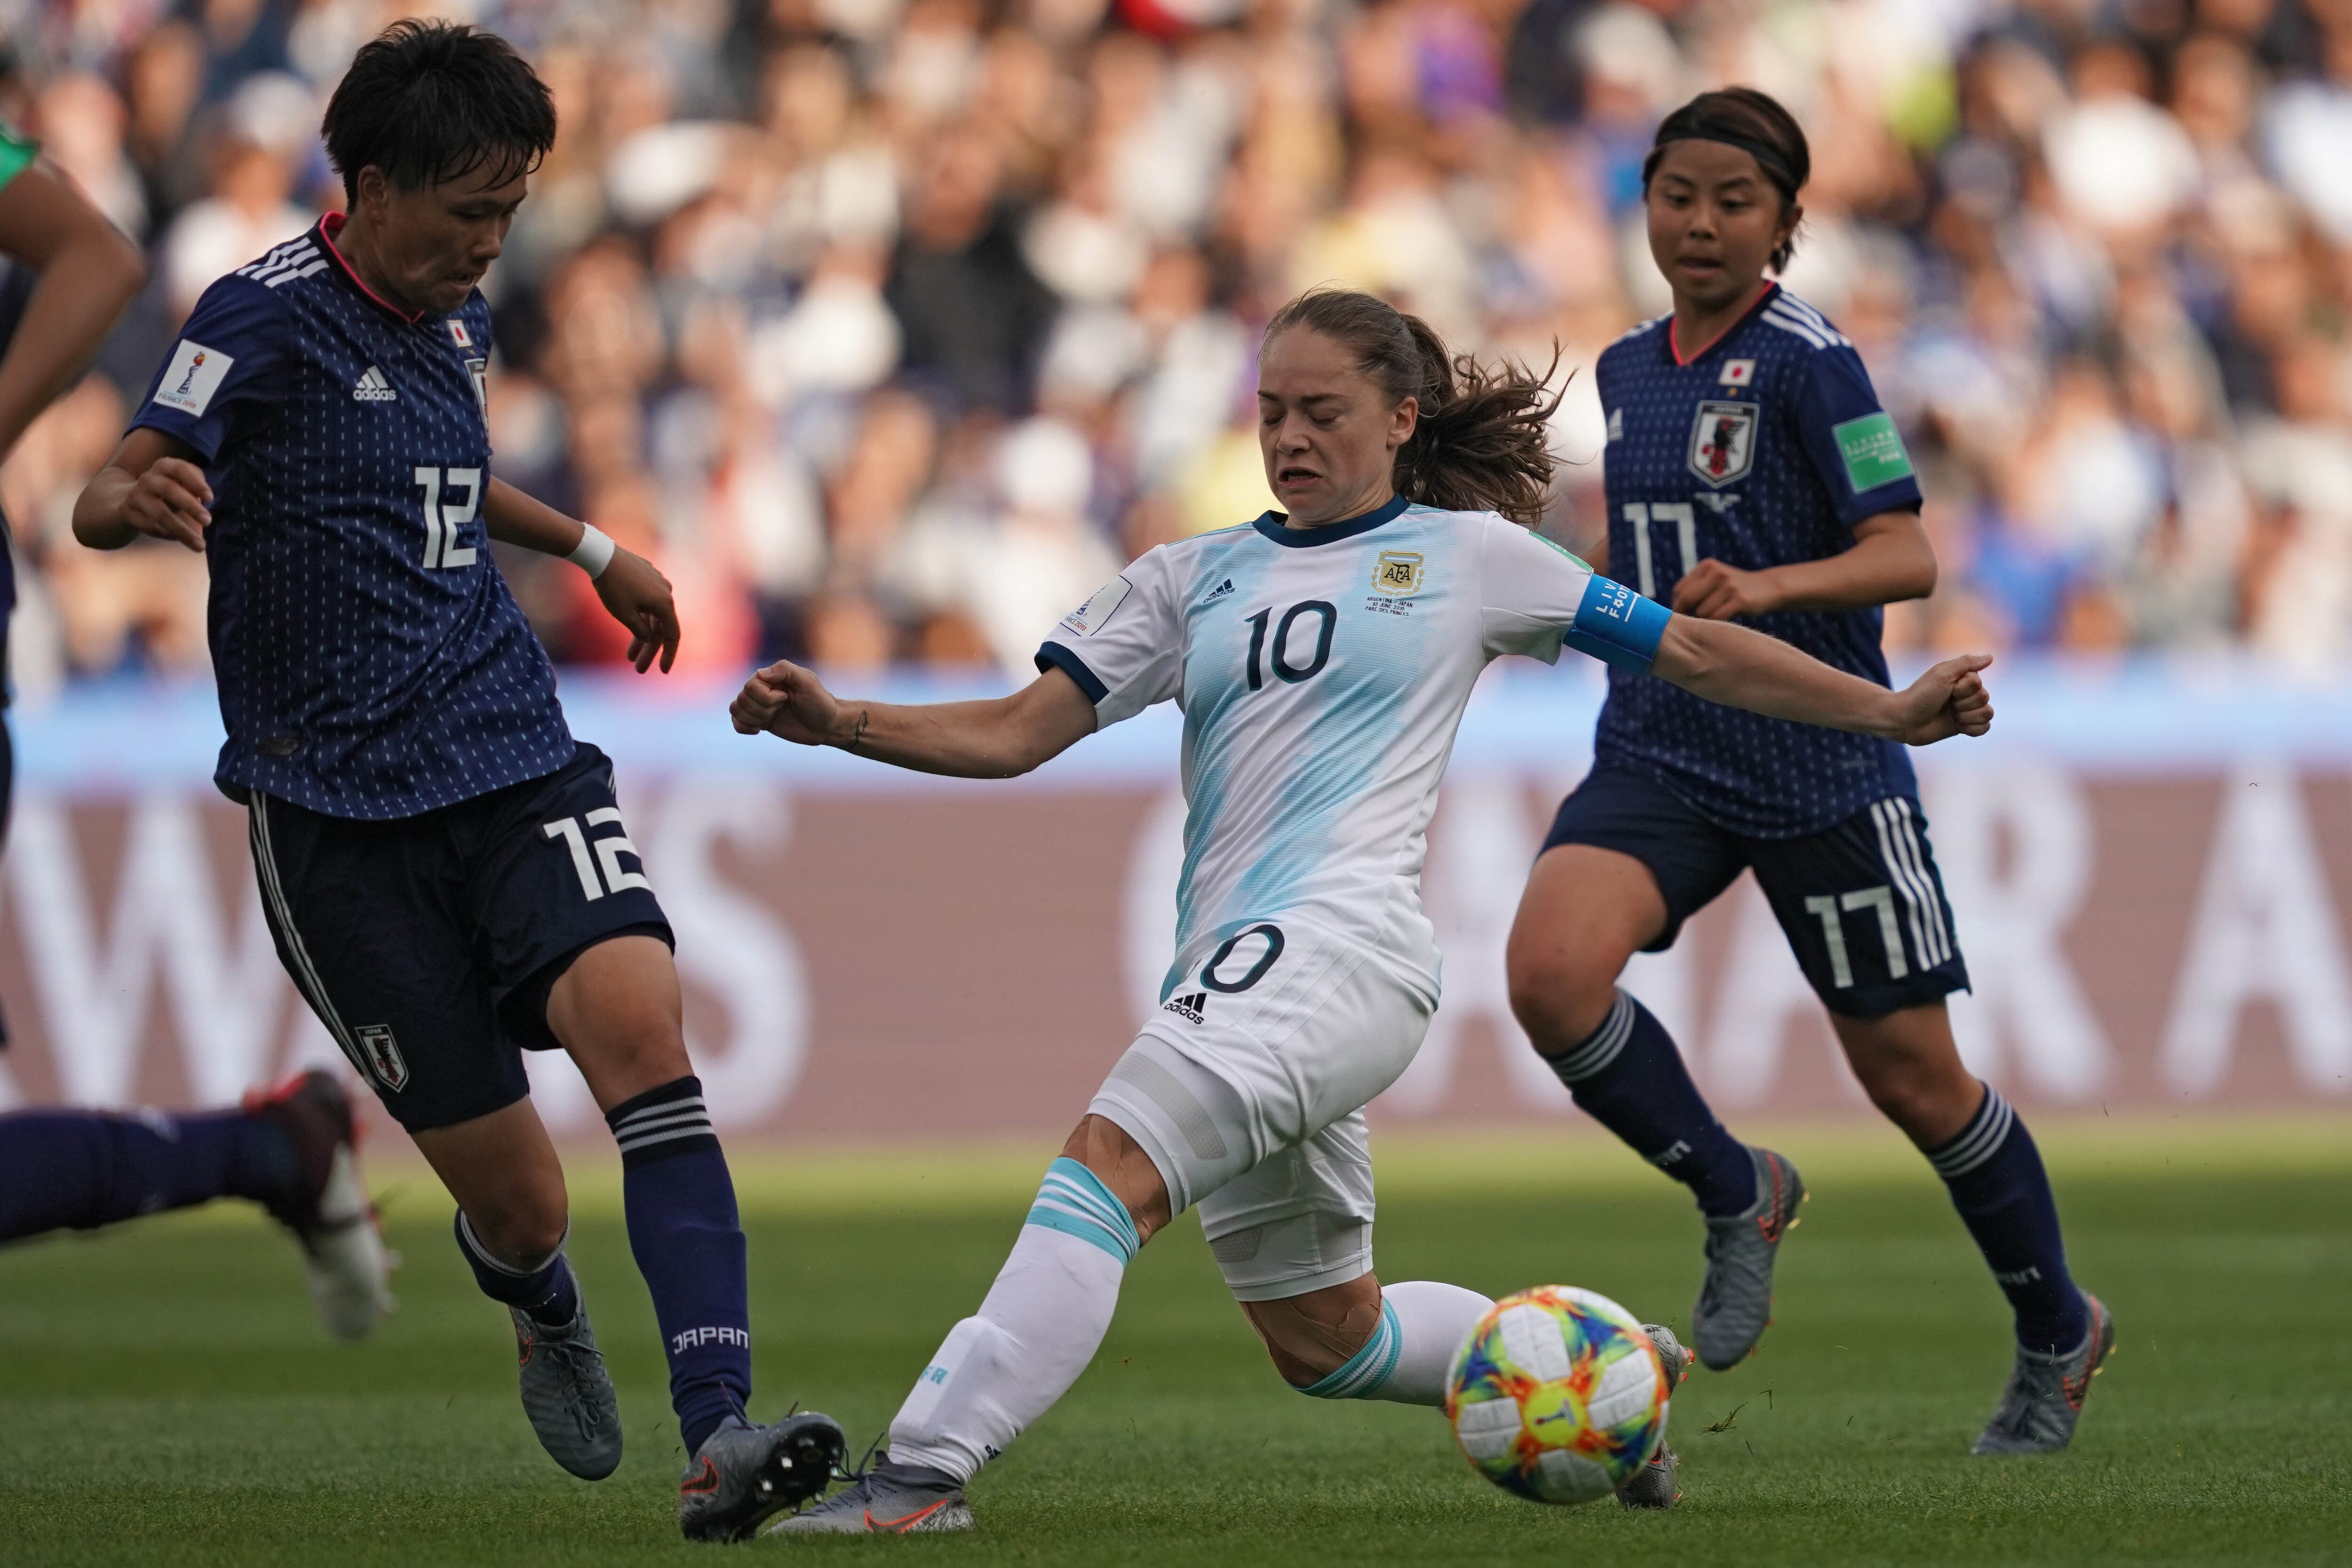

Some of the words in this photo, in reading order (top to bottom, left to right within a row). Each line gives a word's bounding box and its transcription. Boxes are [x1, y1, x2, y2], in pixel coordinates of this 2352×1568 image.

[353, 387, 397, 401] adidas
[415, 467, 481, 568] 12
[1384, 562, 1411, 583] AFA
[1623, 501, 1698, 598] 17
[1203, 587, 1236, 603] adidas
[1074, 621, 1088, 631] 2019
[1244, 599, 1337, 692] 10
[543, 806, 655, 901] 12
[1185, 924, 1285, 994] 0
[1804, 884, 1908, 988] 17
[1164, 1003, 1205, 1025] adidas
[672, 1326, 749, 1355] JAPAN
